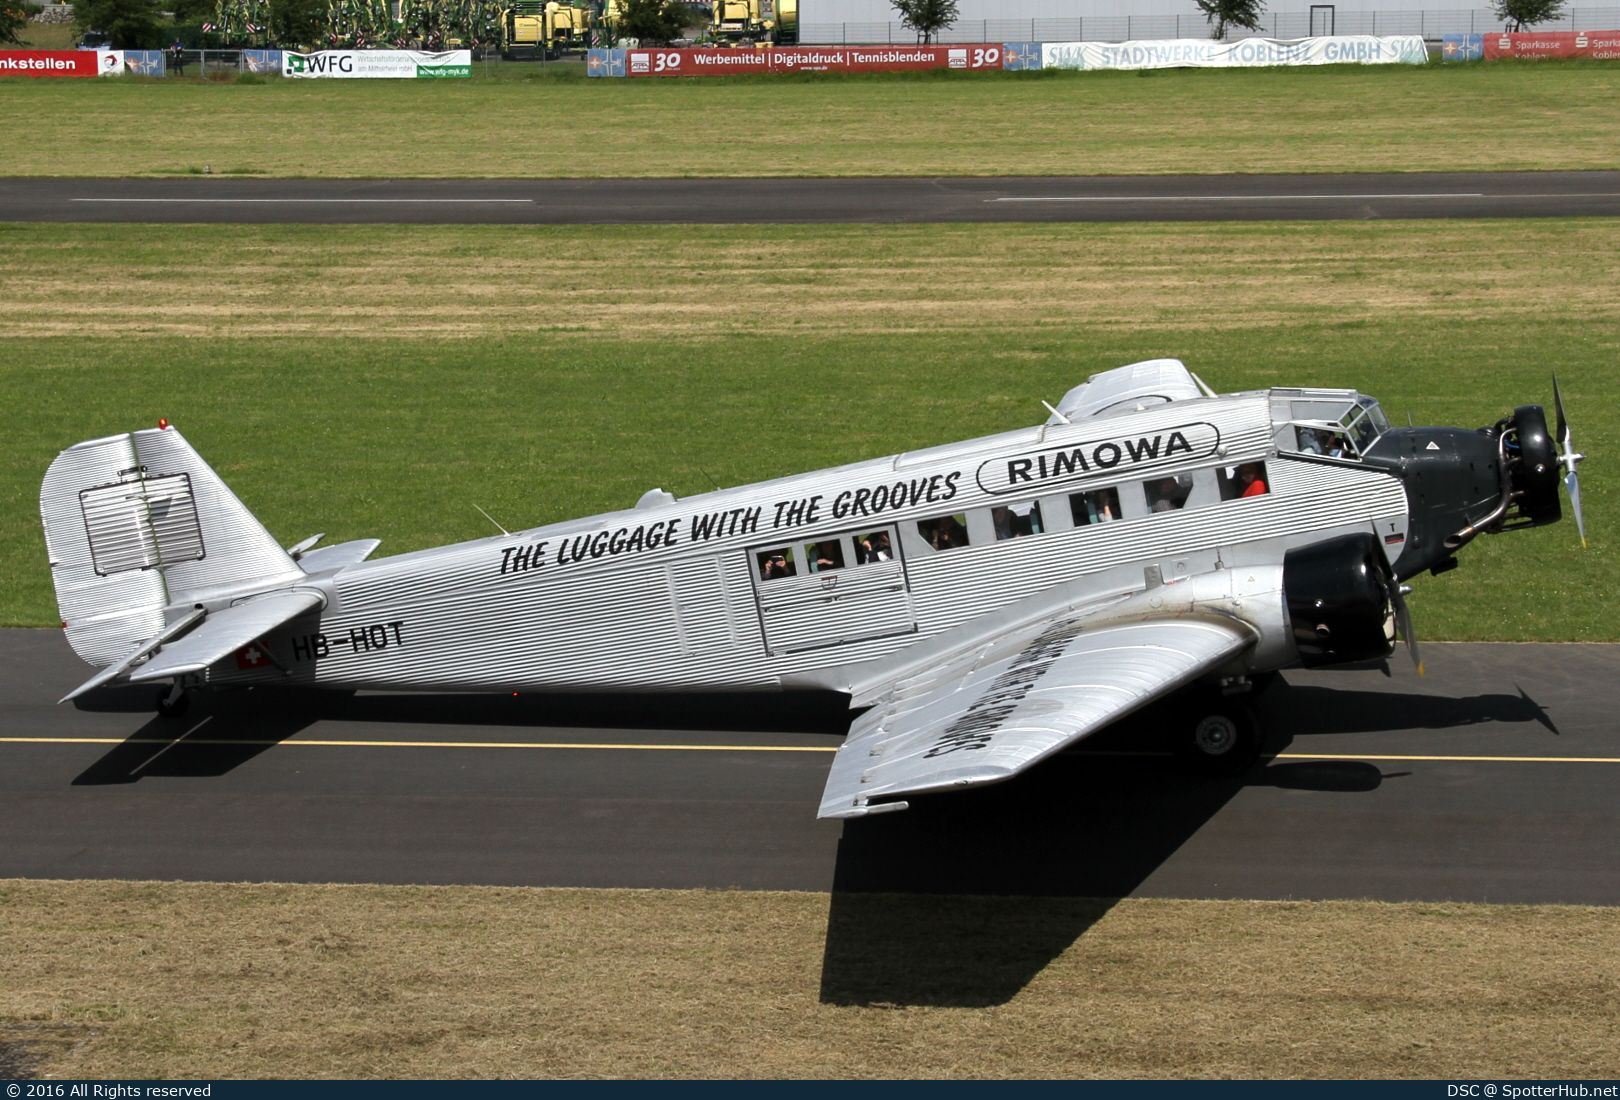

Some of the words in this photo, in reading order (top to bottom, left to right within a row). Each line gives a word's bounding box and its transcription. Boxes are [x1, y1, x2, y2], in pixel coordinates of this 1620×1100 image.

[1101, 45, 1216, 65] STADTWERKE
[1228, 41, 1312, 63] KOBLENZ
[1324, 41, 1381, 60] GMBH
[1516, 40, 1560, 50] Sparkasse
[0, 57, 76, 69] nkstellen
[307, 55, 353, 73] WFG
[654, 52, 681, 72] 30
[694, 53, 765, 65] Werbemittel
[774, 52, 844, 67] Digitaldruck
[852, 51, 935, 63] Tennisblenden
[972, 48, 999, 68] 30
[1008, 431, 1194, 485] RIMOWA
[501, 541, 549, 575] THE
[556, 518, 682, 565] LUGGAGE
[691, 505, 762, 542] WITH
[773, 494, 824, 529] THE
[832, 471, 962, 519] GROOVES
[292, 621, 403, 661] HB-HOT
